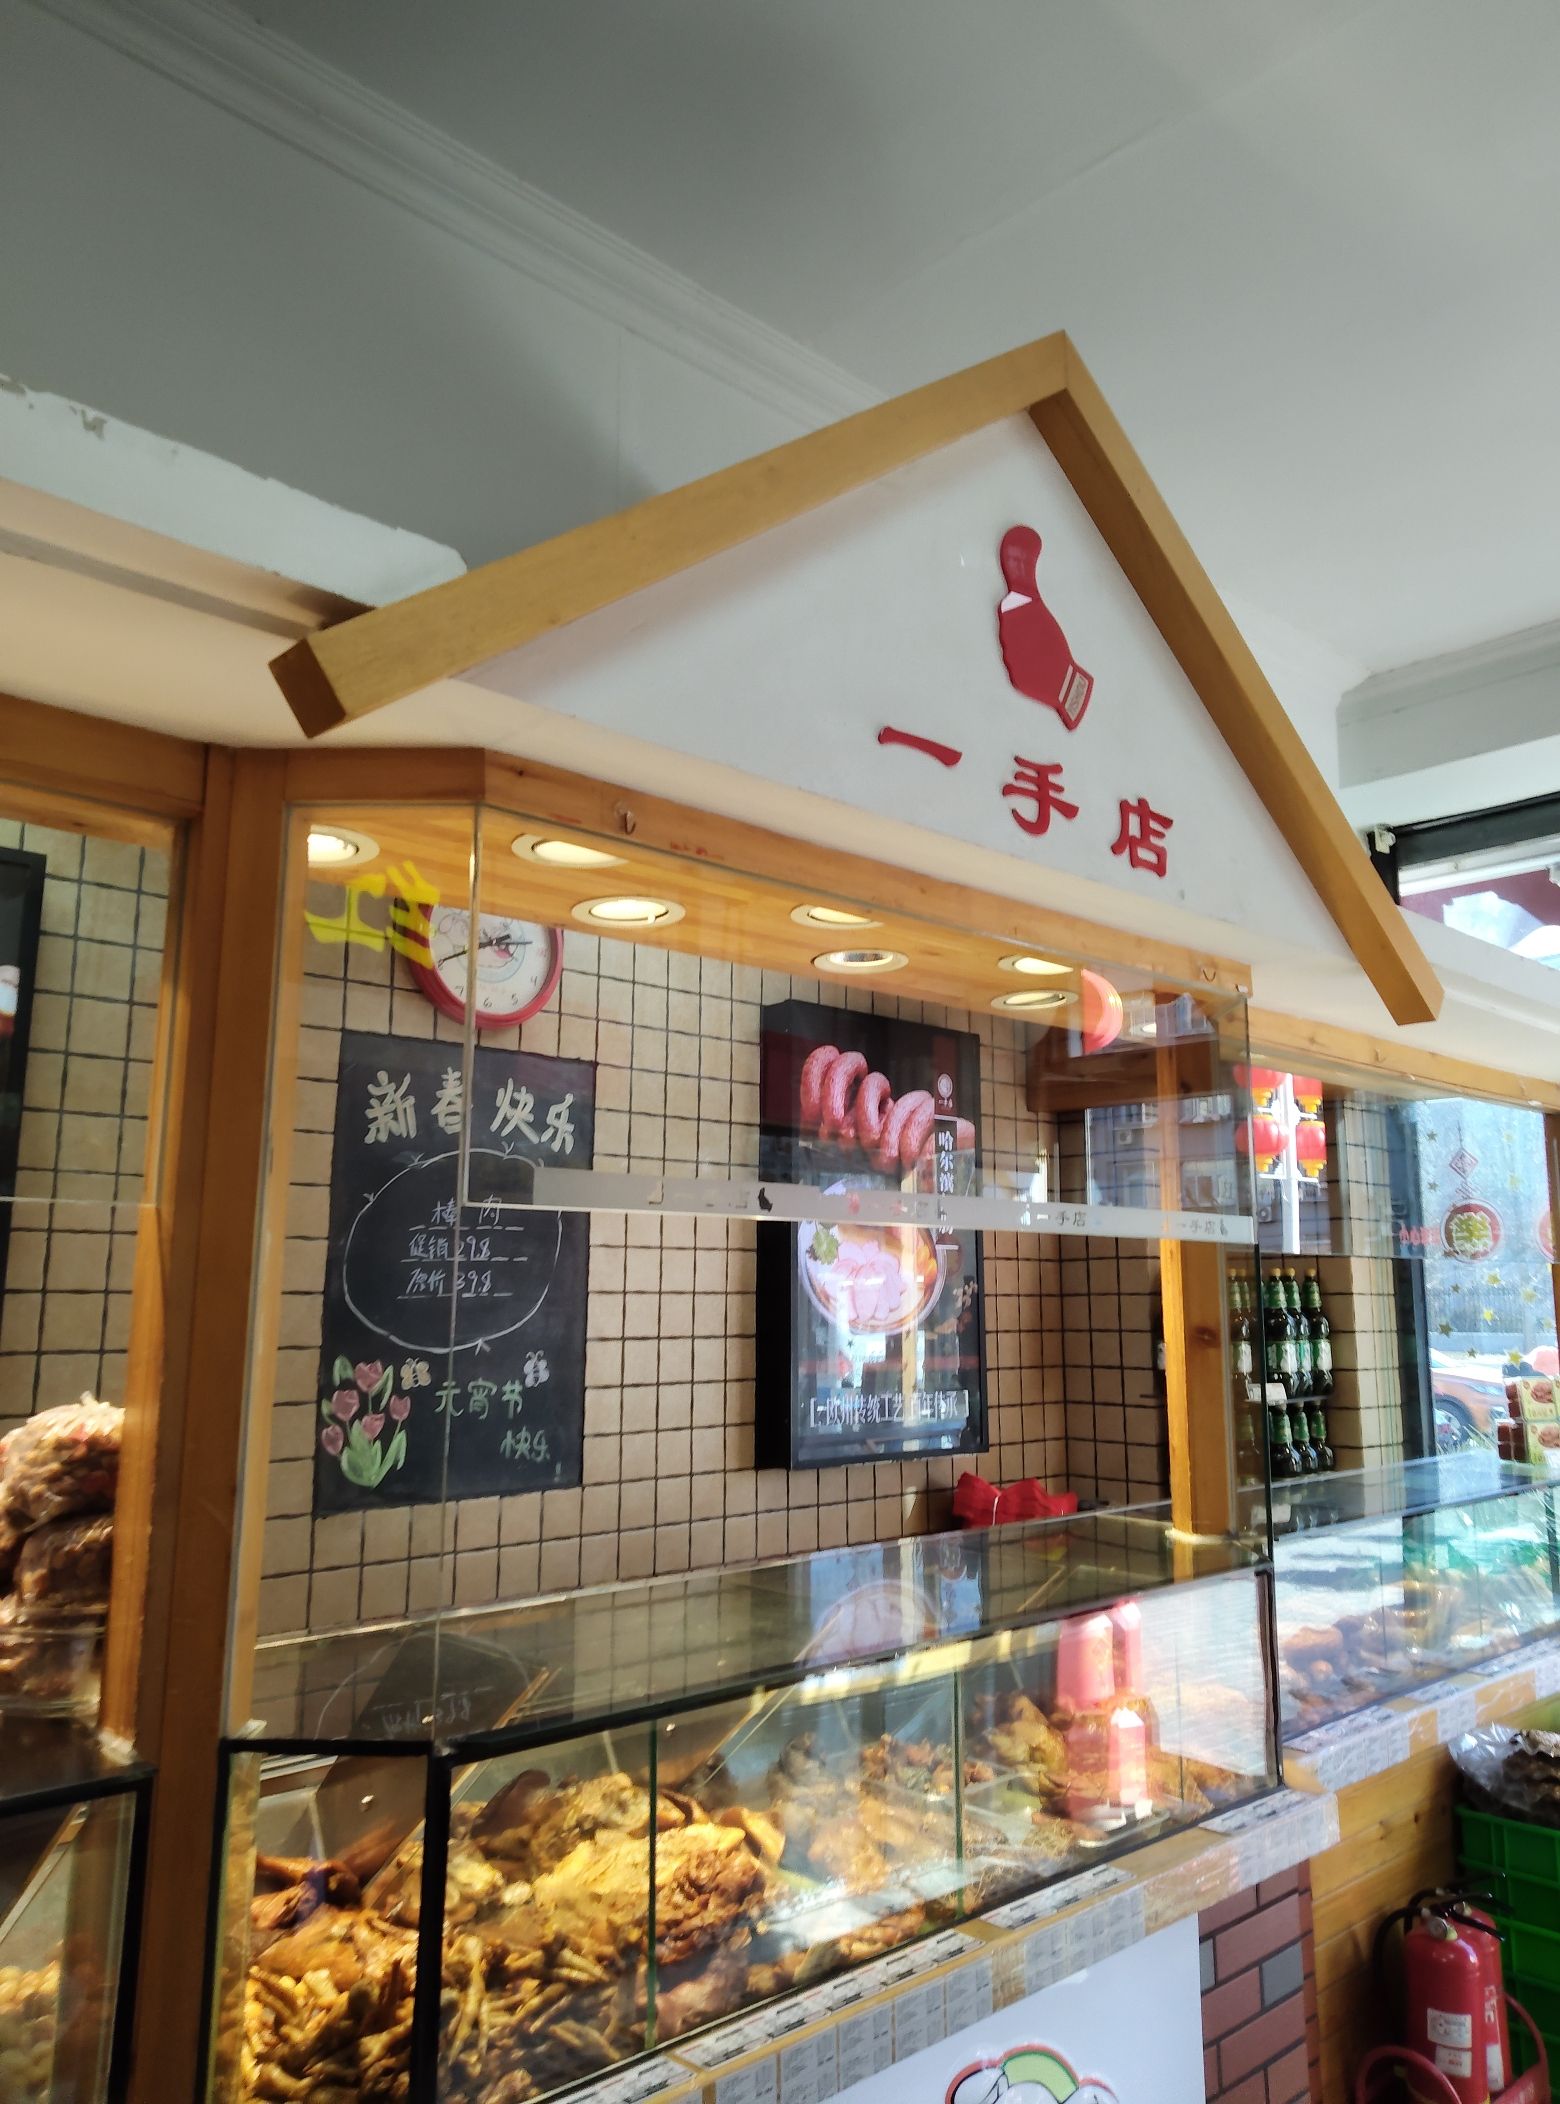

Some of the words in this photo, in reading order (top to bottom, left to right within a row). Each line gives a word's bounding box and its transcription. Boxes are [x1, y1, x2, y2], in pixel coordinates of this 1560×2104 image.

[877, 726, 1174, 879] 一手店
[364, 1066, 575, 1155] 新春快乐
[434, 1376, 524, 1421] 元宵节
